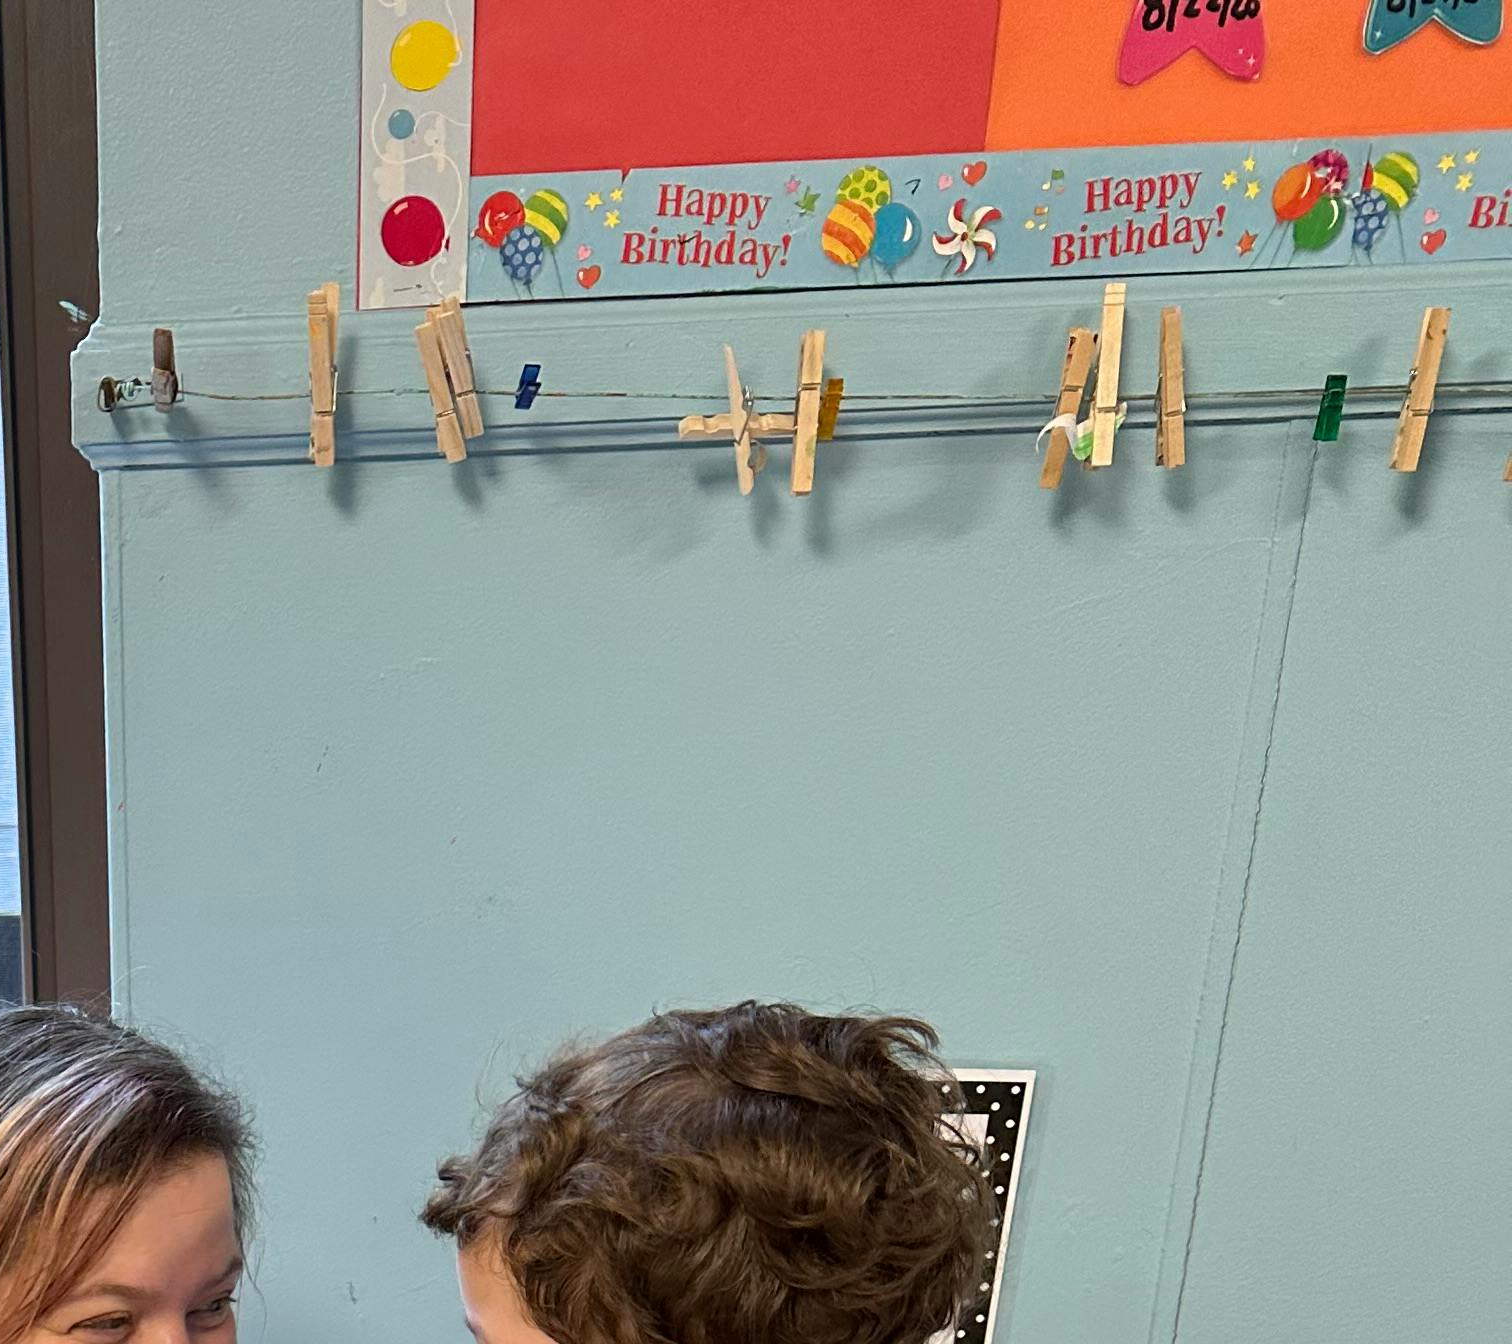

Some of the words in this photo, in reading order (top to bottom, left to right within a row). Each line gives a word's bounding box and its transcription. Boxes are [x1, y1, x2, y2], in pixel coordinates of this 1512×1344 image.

[655, 183, 772, 230] Happy
[1084, 171, 1203, 214] Happy
[1467, 187, 1512, 229] Bi
[620, 225, 792, 279] Birthday!
[1050, 204, 1226, 267] Birthday!
